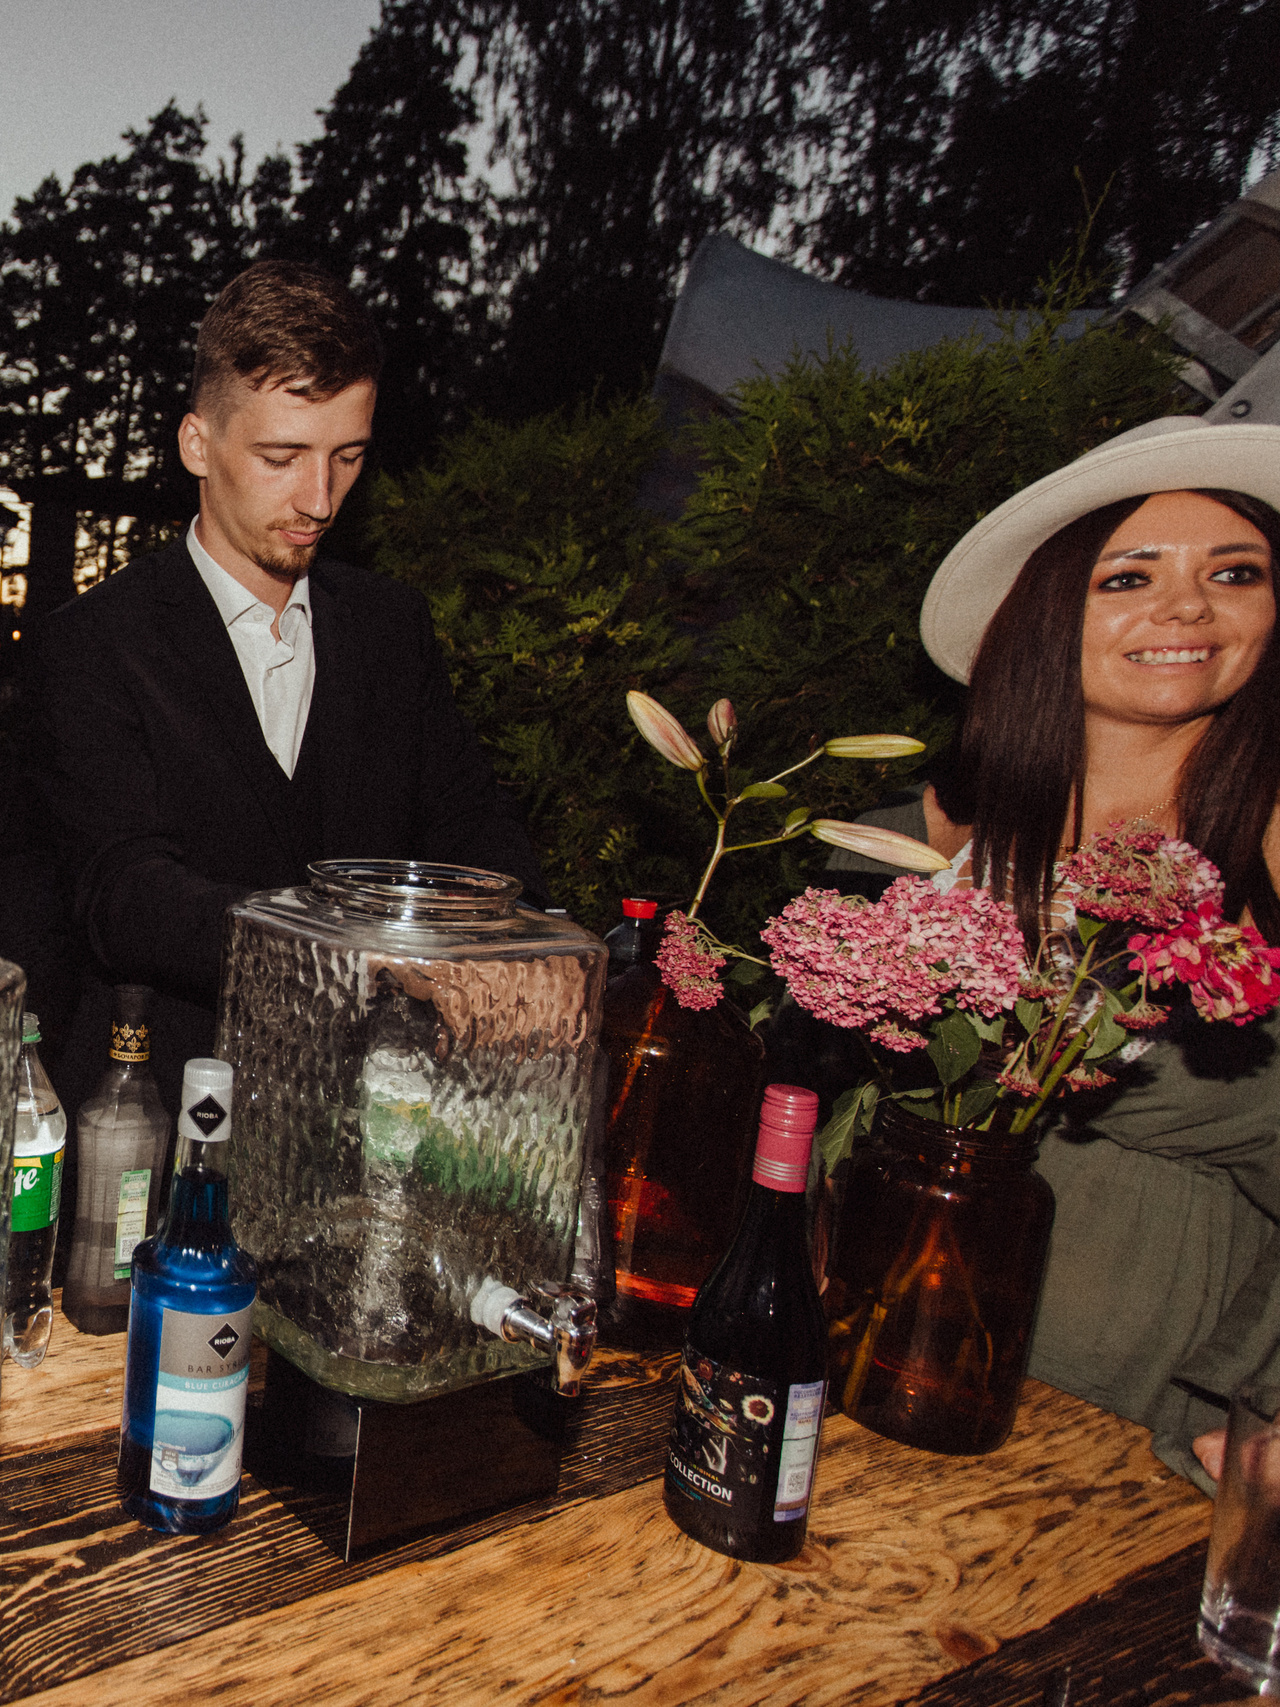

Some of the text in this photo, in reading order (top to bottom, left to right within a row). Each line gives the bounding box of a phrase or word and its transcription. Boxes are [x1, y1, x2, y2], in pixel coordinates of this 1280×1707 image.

[196, 1111, 219, 1119] RIOBA
[13, 1168, 38, 1197] te
[214, 1336, 235, 1345] RIOBA
[187, 1364, 212, 1373] BAR
[184, 1381, 208, 1390] BLUE
[669, 1451, 733, 1501] COLLECTION
